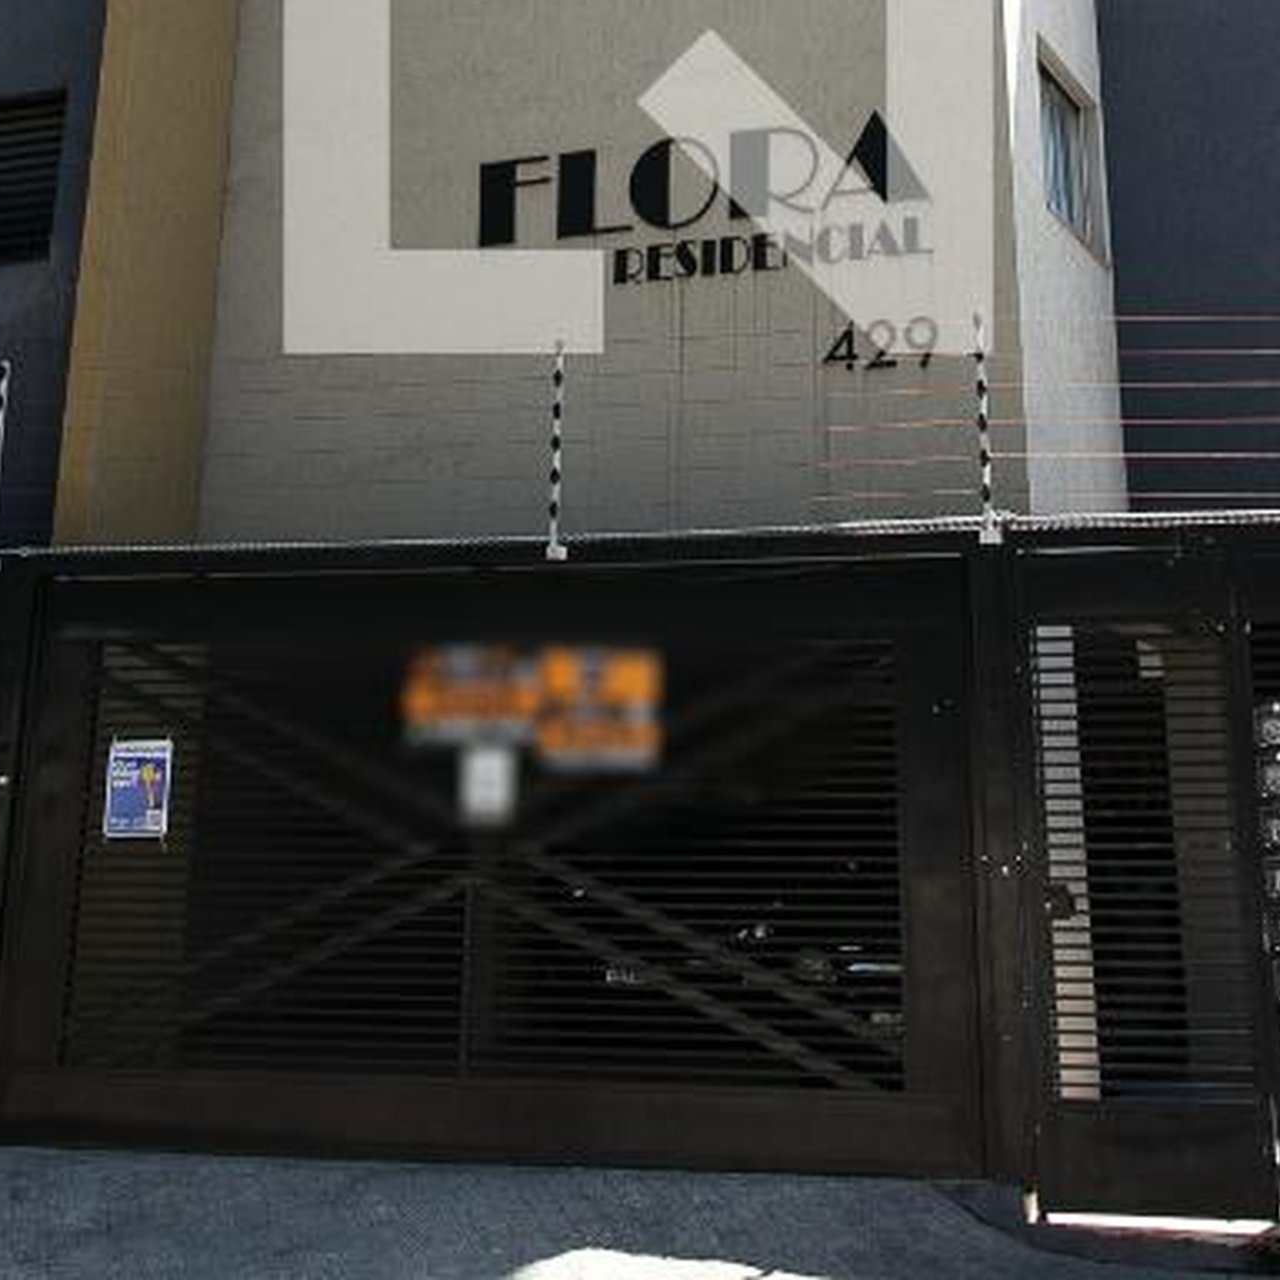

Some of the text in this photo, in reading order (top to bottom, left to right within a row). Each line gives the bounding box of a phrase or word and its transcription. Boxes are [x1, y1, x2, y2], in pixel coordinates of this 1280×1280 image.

[479, 110, 932, 248] FLORA
[613, 217, 934, 285] RESIDENCIAL
[823, 316, 938, 370] 429
